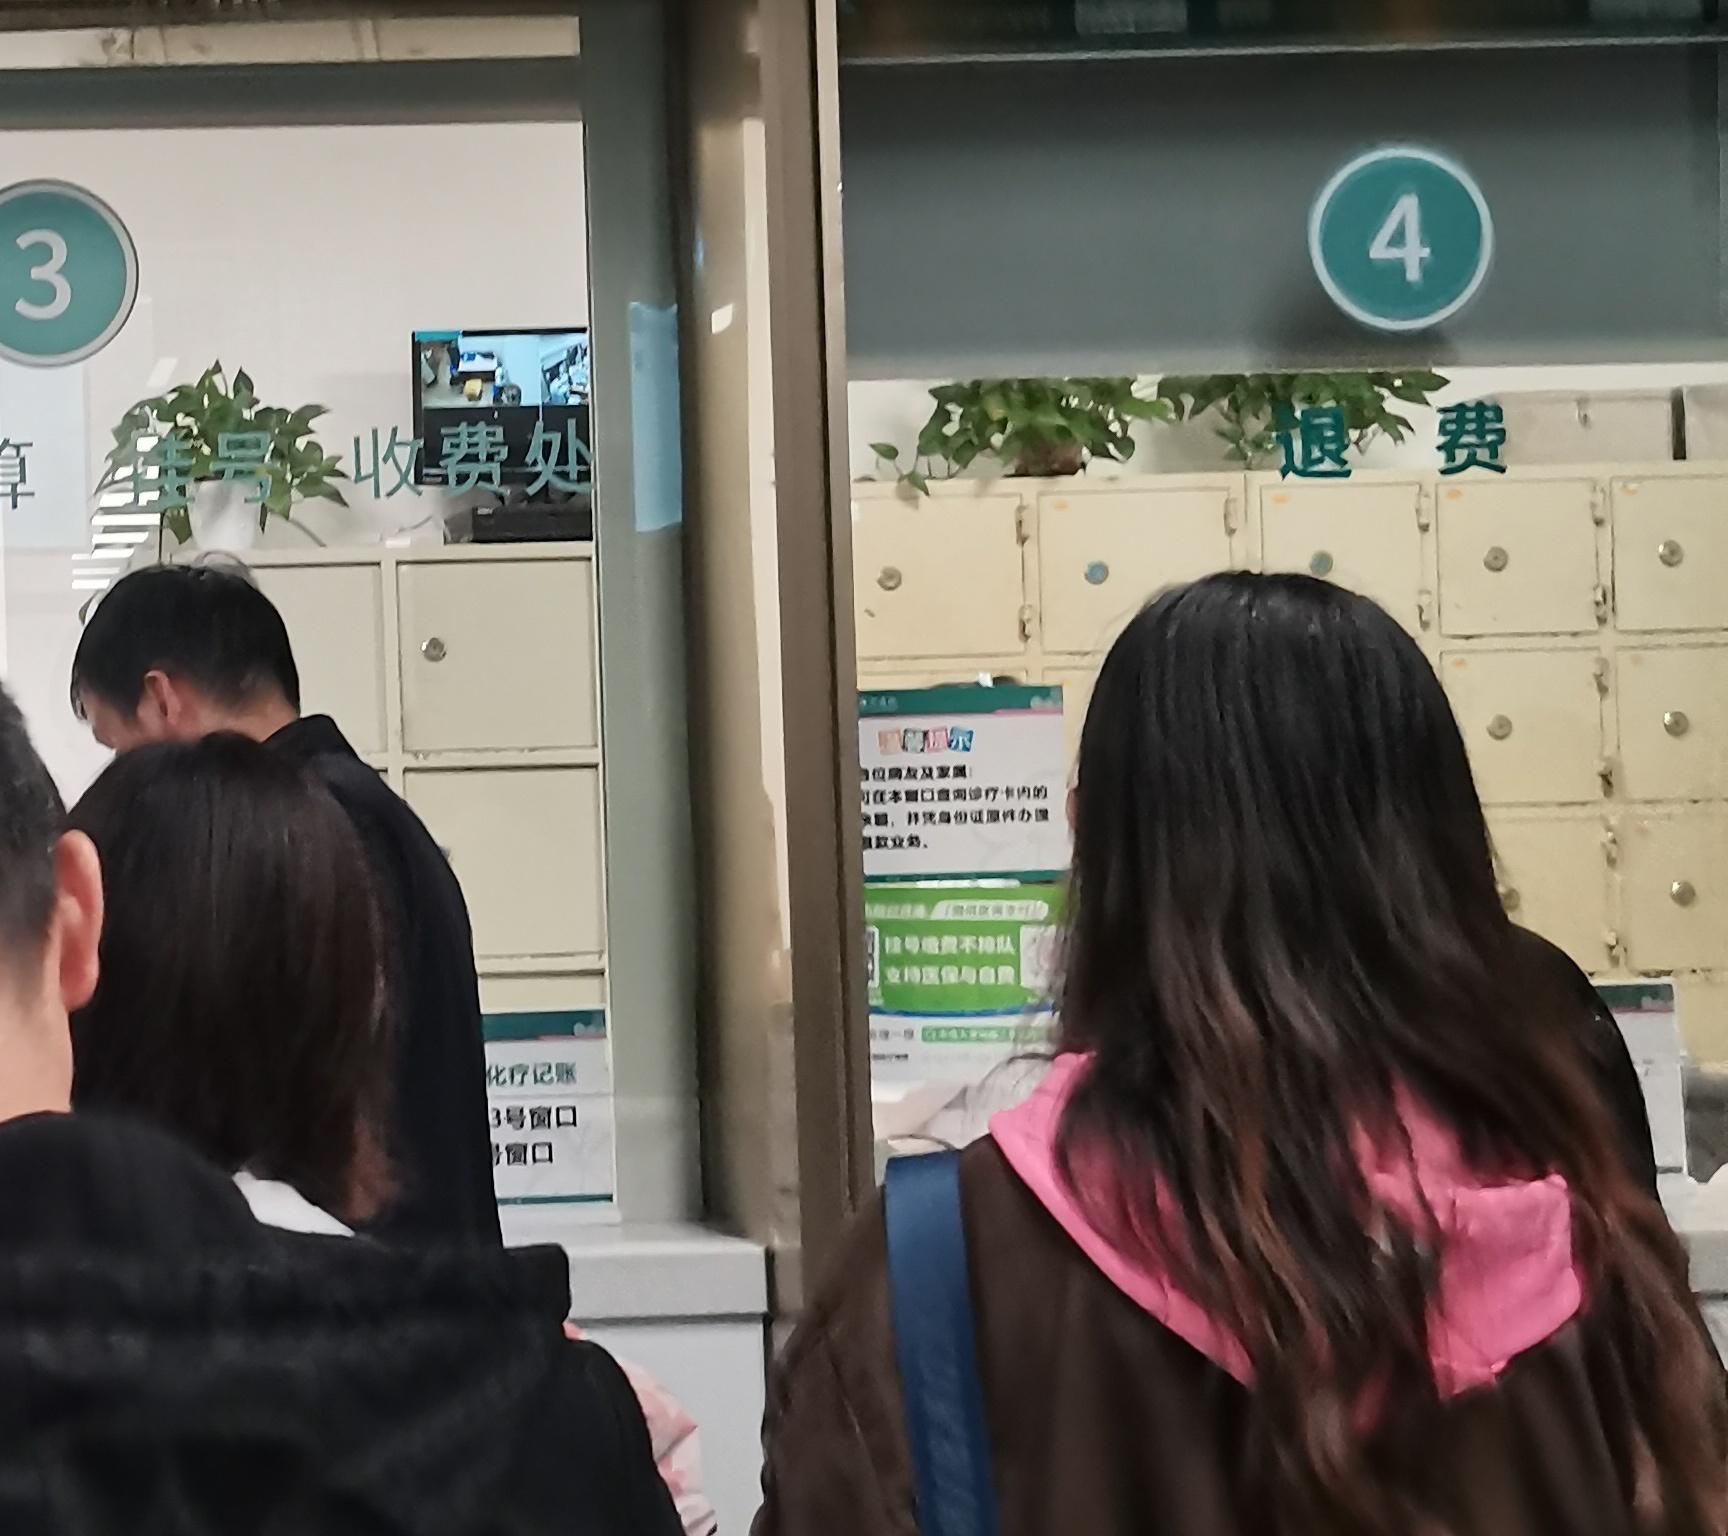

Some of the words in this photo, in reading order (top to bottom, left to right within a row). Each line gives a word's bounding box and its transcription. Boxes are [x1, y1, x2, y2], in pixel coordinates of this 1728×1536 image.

[12, 228, 73, 323] 3
[1368, 192, 1432, 284] 4
[353, 417, 595, 499] 收费处
[1275, 402, 1508, 481] 退费
